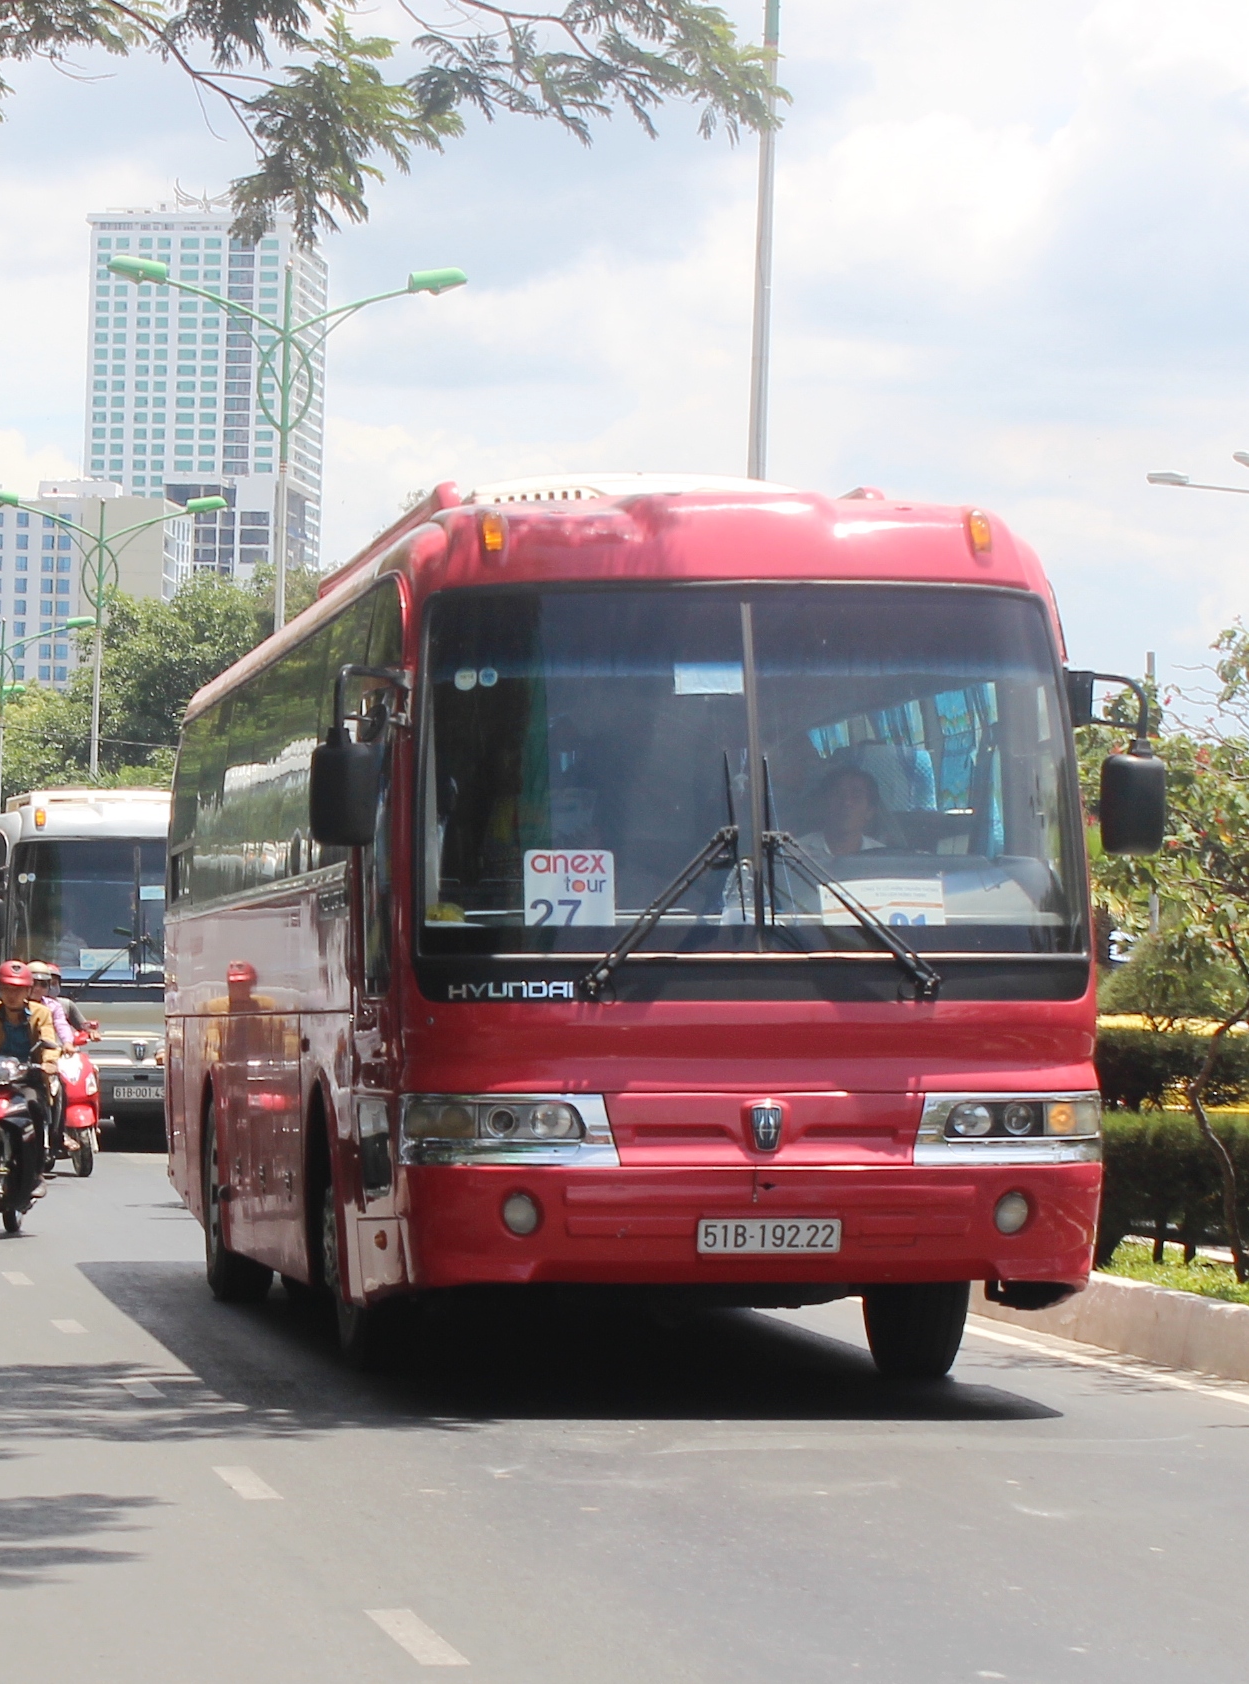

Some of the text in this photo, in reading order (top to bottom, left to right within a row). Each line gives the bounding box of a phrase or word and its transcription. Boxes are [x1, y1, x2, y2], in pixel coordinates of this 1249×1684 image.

[530, 854, 606, 874] anex
[564, 876, 606, 893] tour
[530, 899, 582, 926] 27
[448, 981, 575, 999] HYUNDAI
[703, 1224, 835, 1248] 51B-192.22
